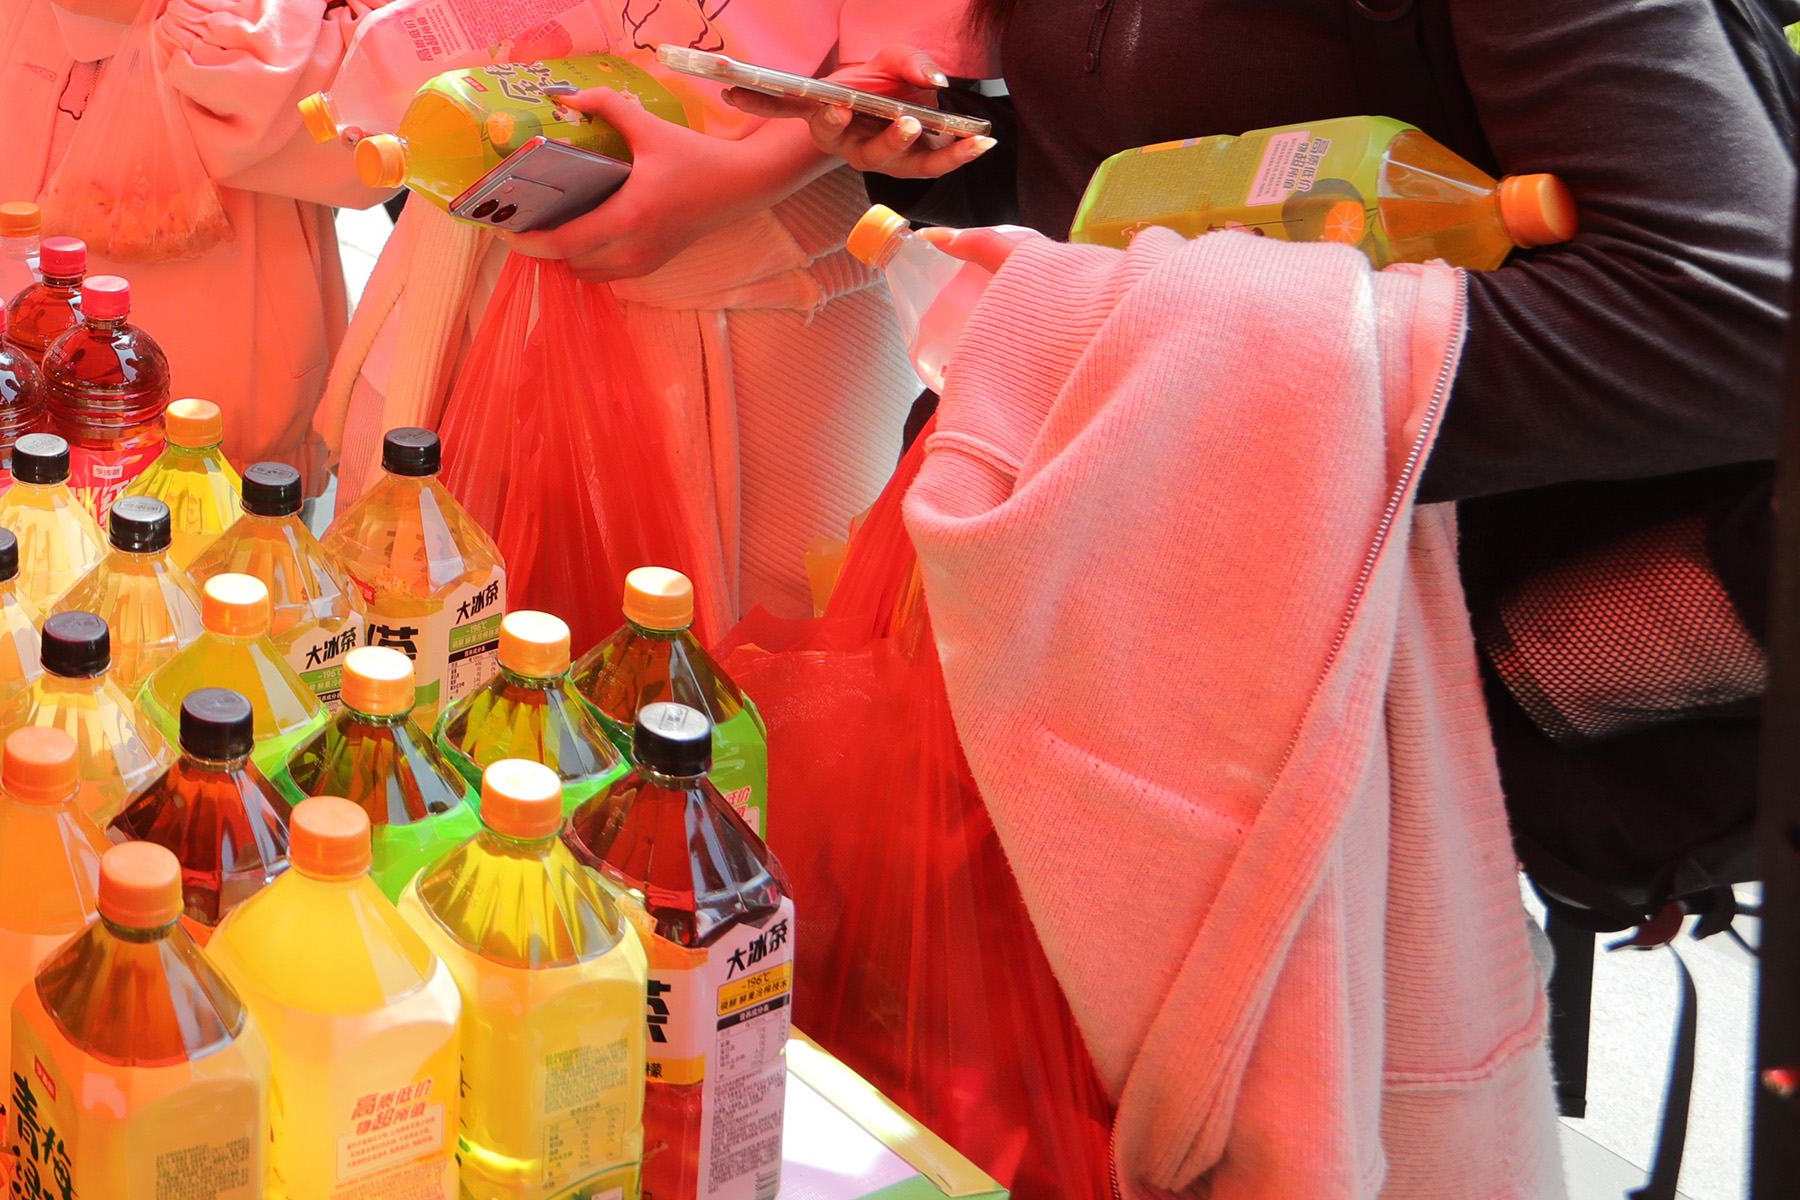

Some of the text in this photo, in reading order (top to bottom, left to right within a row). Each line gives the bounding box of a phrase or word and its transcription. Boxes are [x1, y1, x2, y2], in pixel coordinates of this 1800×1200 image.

[456, 580, 499, 625] 大冰茶
[305, 626, 357, 670] 大冰茶
[726, 918, 789, 981] 大冰茶
